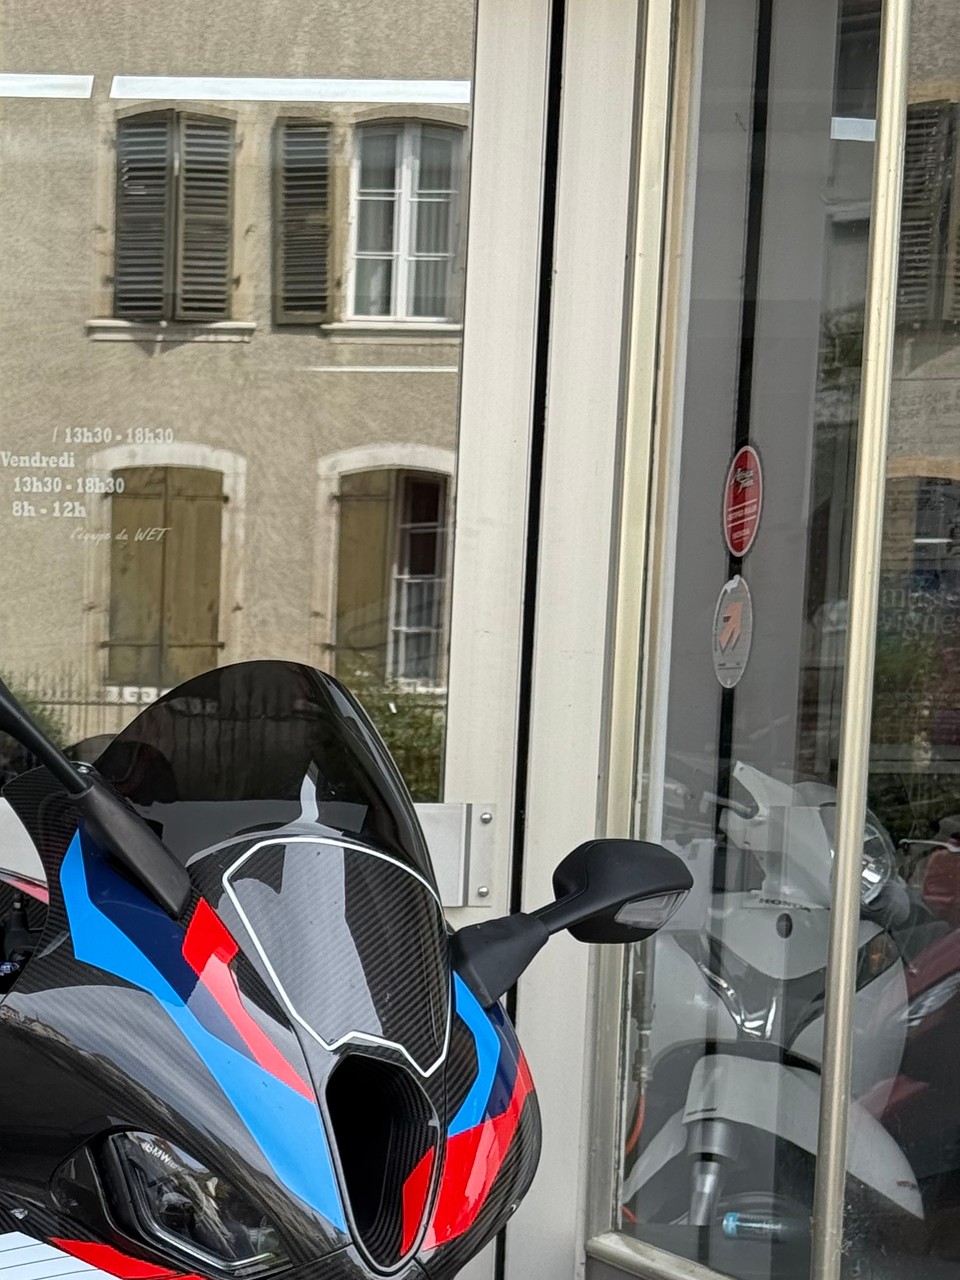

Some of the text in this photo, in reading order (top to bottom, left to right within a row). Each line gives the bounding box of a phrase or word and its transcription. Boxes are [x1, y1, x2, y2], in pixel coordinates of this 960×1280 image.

[52, 426, 58, 443] /
[65, 427, 113, 443] 13h30
[126, 427, 174, 444] 18h30
[0, 450, 75, 468] Vendredi
[14, 476, 62, 493] 13h30
[76, 477, 125, 494] 18h30
[12, 501, 36, 517] 8h
[52, 501, 87, 518] 12h
[134, 527, 172, 542] WET
